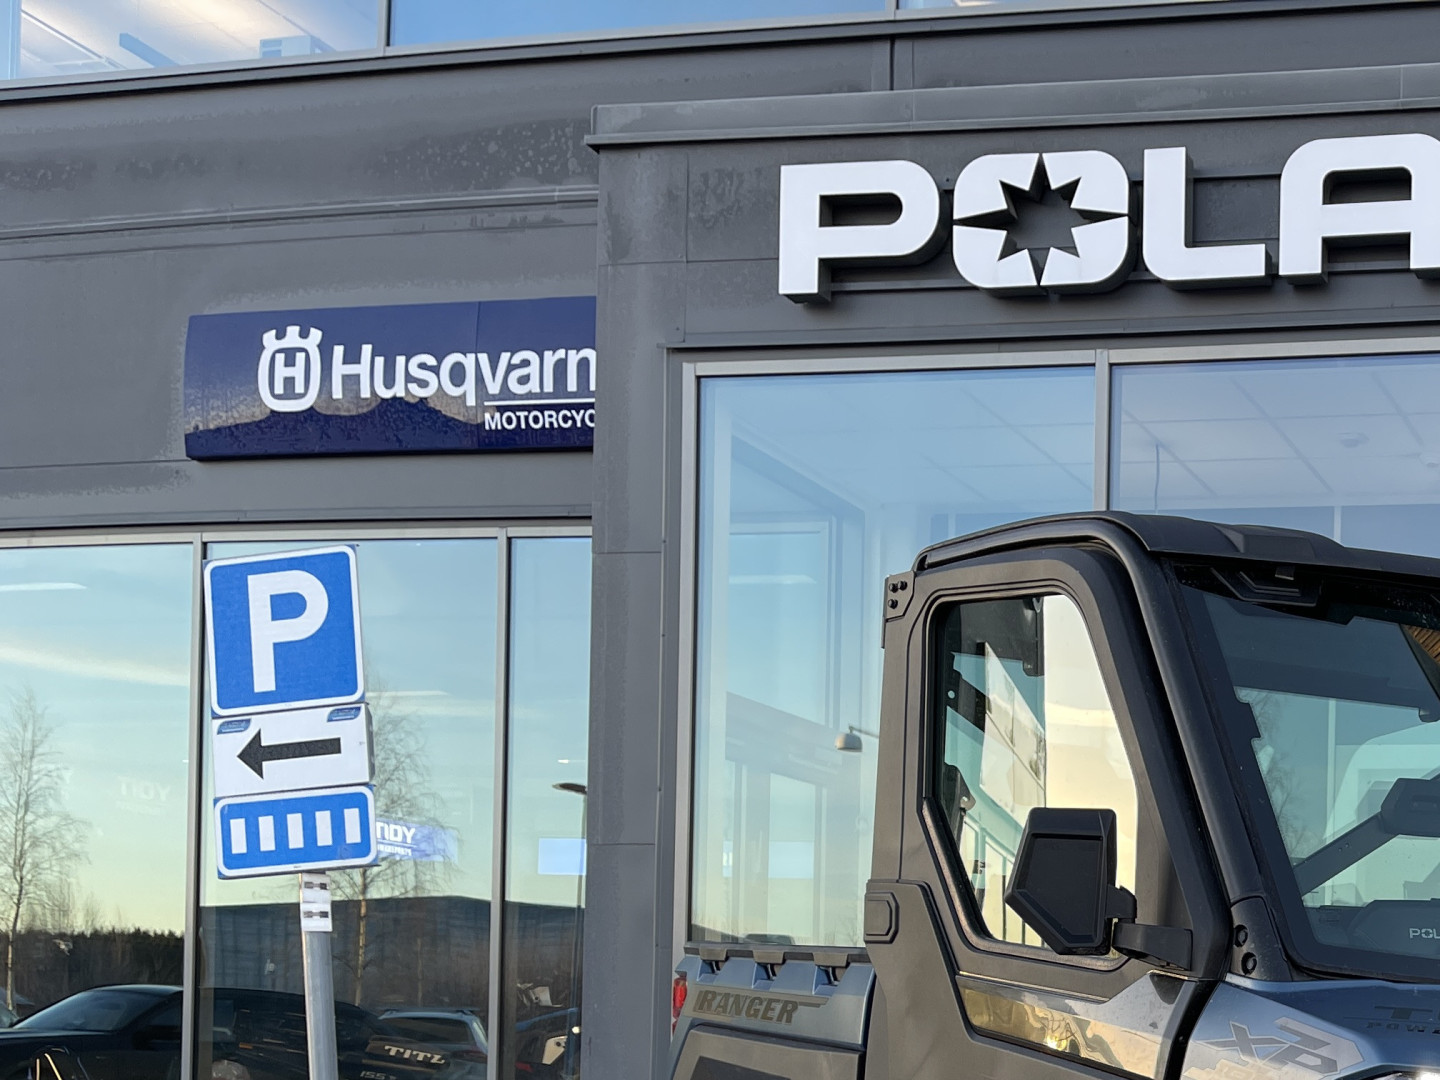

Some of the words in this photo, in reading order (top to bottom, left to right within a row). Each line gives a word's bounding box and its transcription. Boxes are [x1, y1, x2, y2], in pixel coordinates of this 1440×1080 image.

[247, 569, 329, 693] P
[693, 989, 799, 1024] RANGER
[1198, 1020, 1340, 1075] XP
